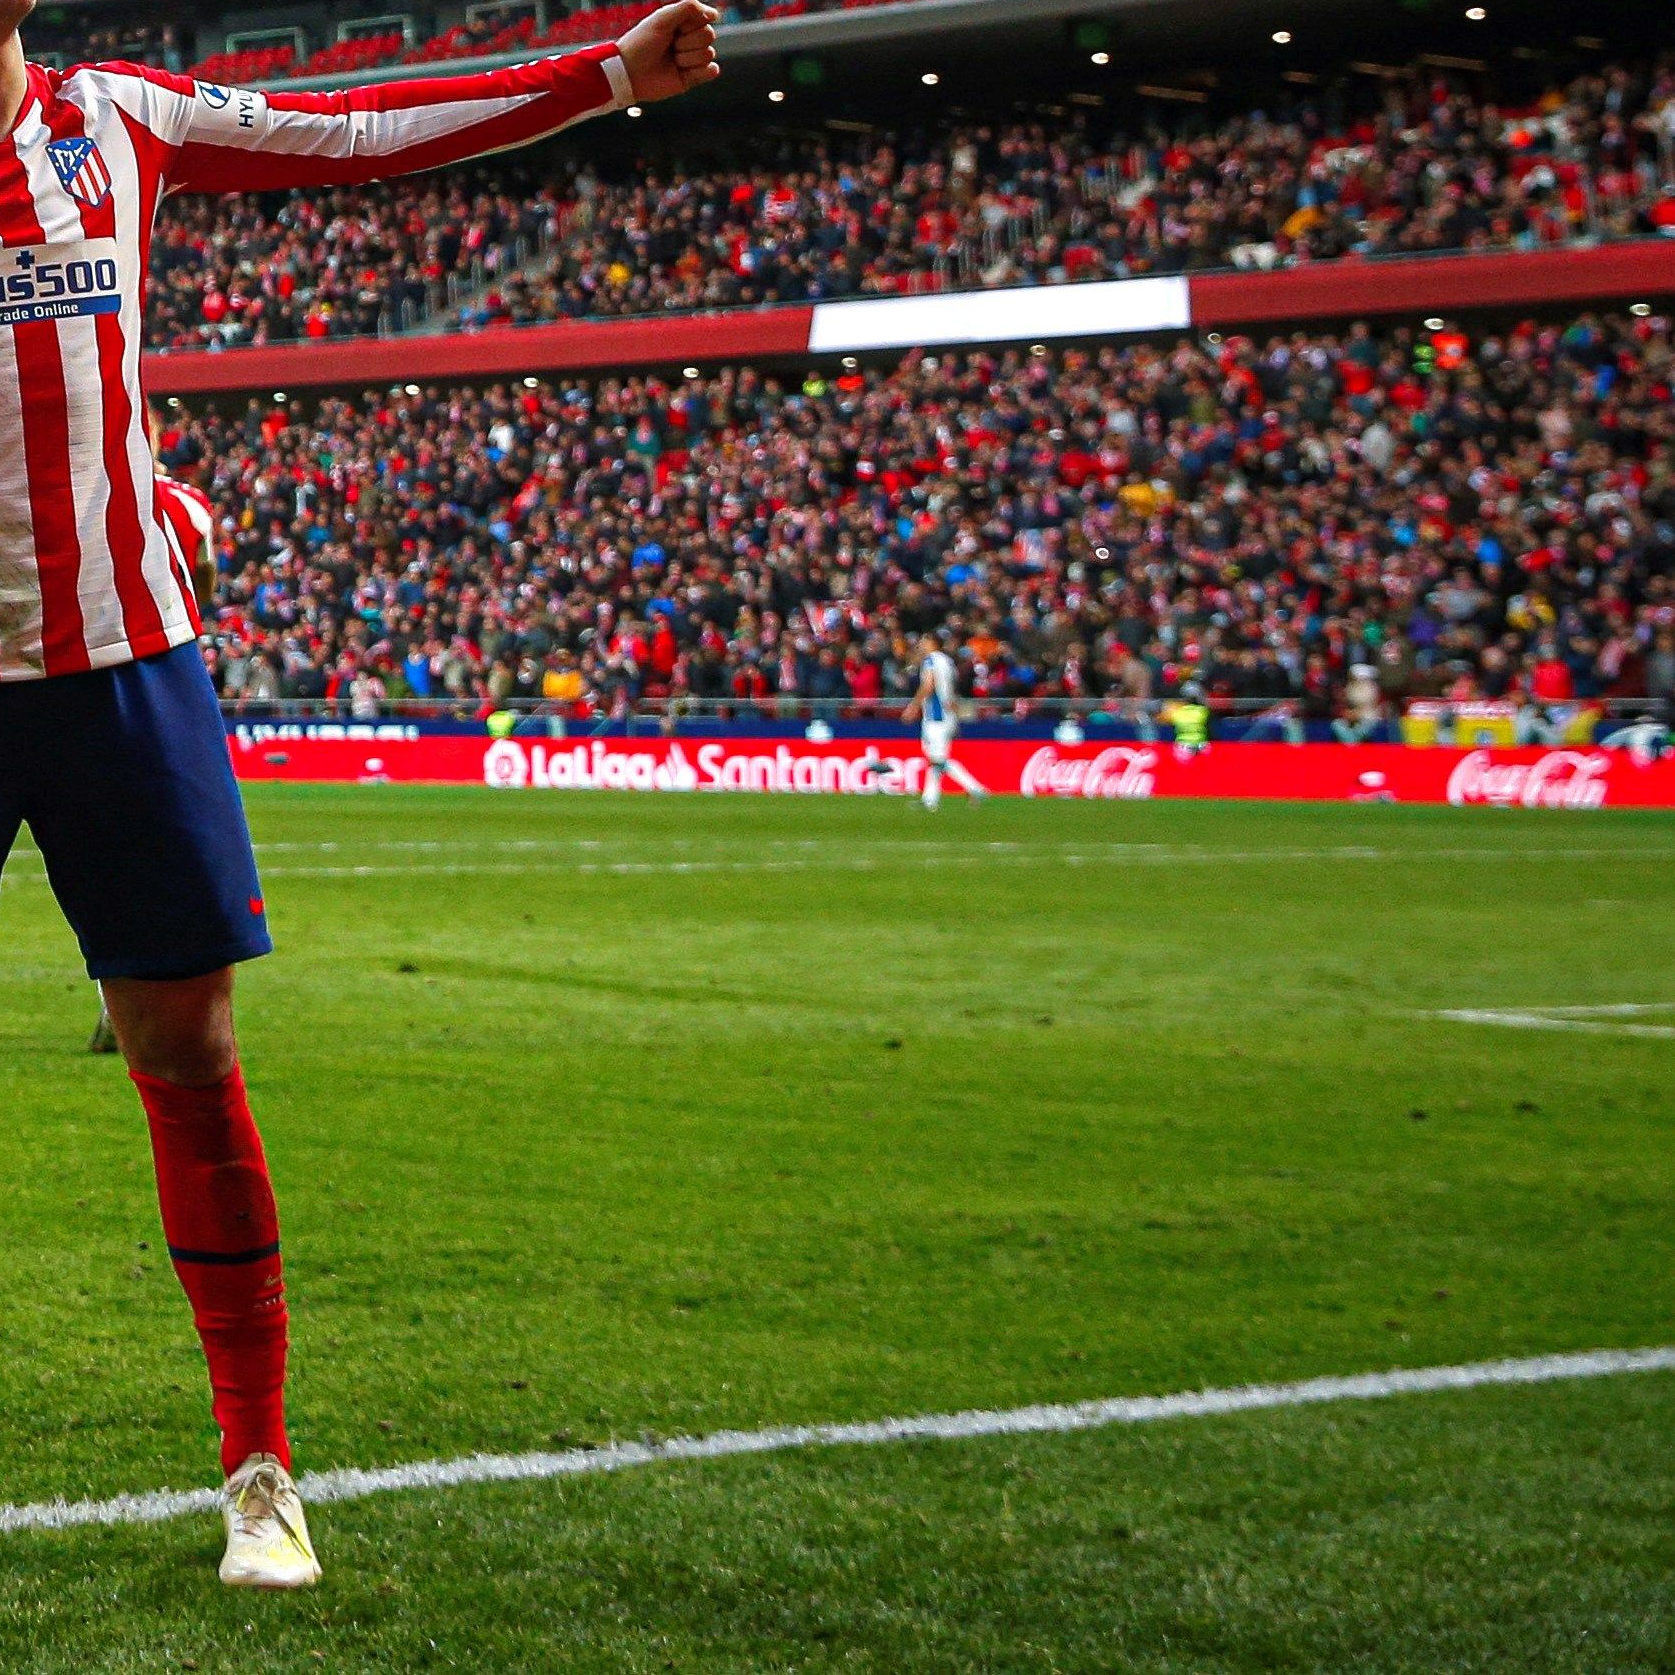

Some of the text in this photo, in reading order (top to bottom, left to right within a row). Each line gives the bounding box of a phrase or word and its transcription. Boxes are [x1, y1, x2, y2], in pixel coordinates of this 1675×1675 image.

[34, 305, 79, 318] Online
[531, 740, 925, 796] LaLiga Santander
